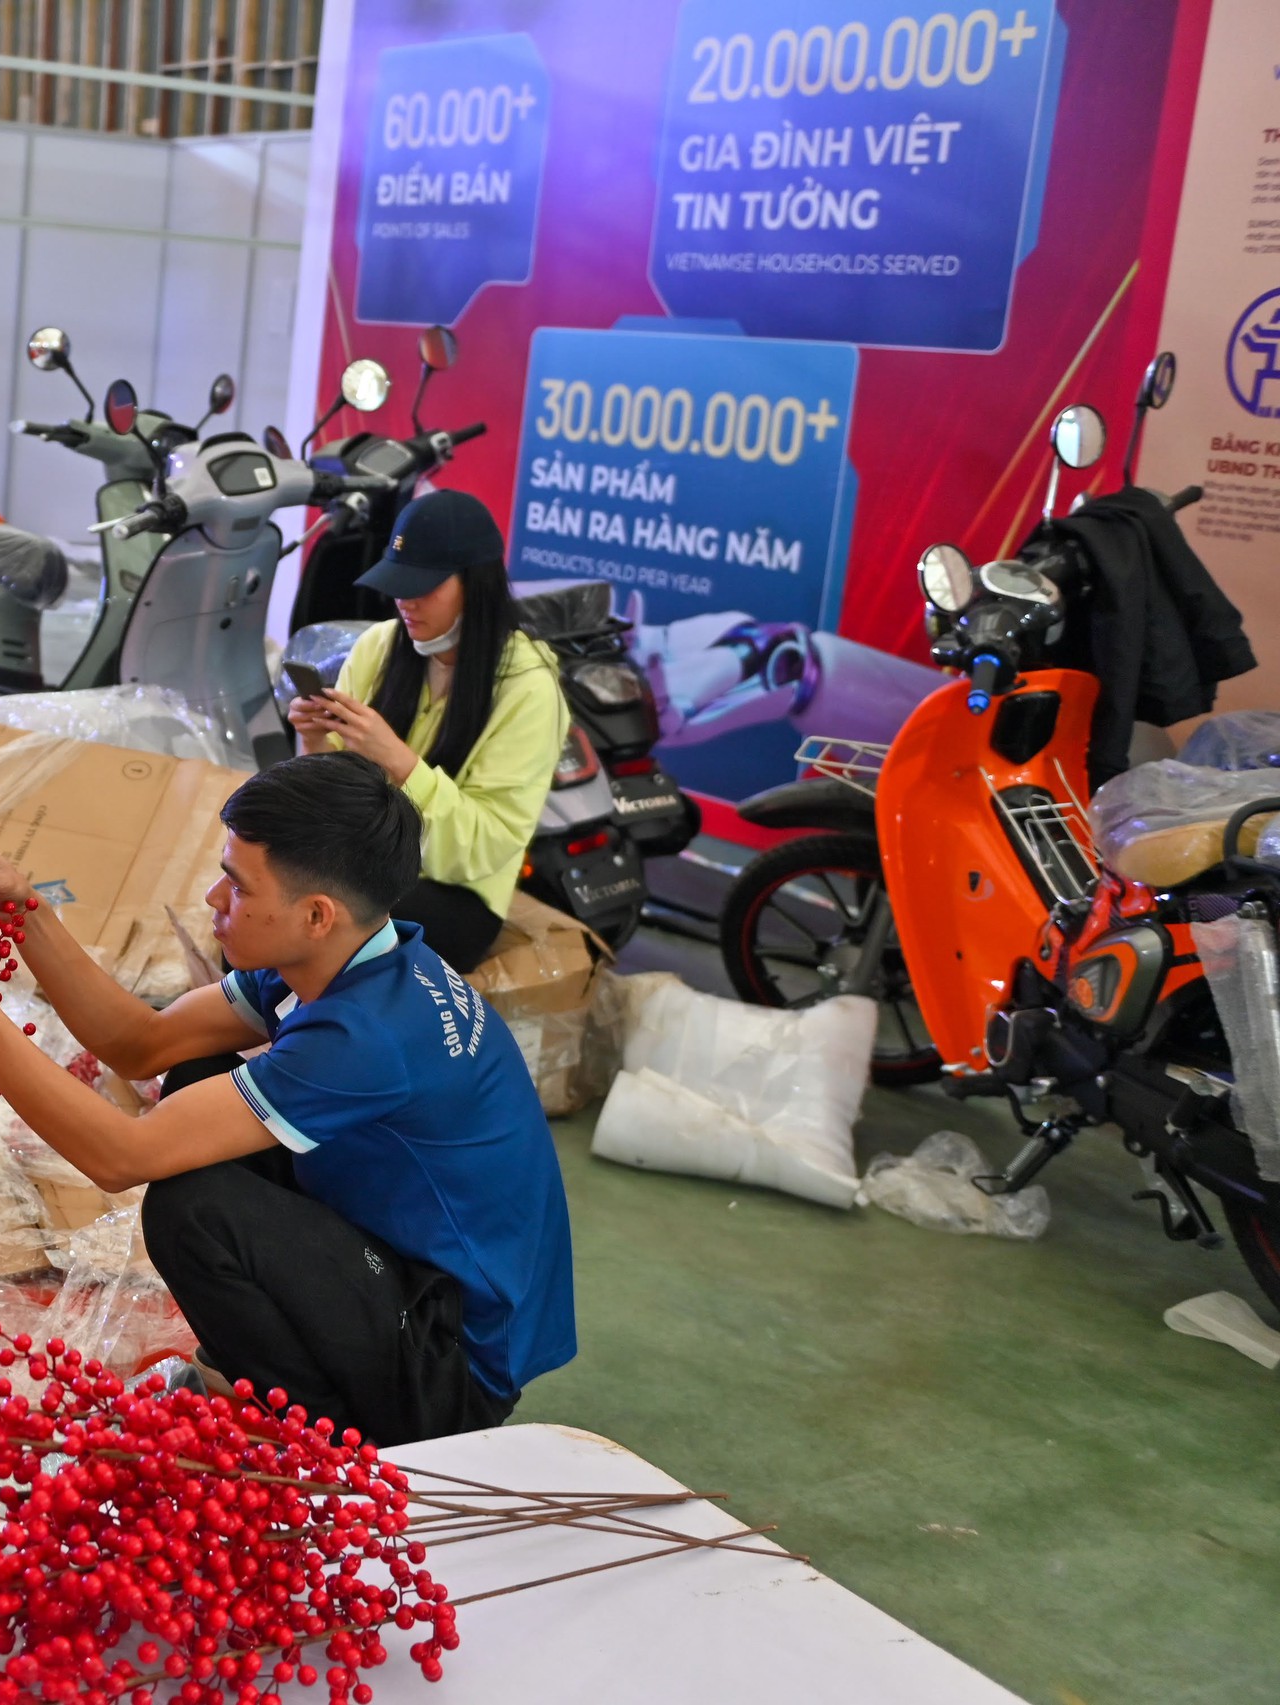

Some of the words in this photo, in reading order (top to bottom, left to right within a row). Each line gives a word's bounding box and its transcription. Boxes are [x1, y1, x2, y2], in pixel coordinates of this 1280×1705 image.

[687, 9, 1038, 104] 20.000.000+
[384, 82, 537, 150] 60.000+
[678, 133, 741, 173] GIA
[749, 120, 853, 171] ĐÌNH
[864, 112, 962, 175] VIỆT
[449, 161, 512, 205] BÁN
[672, 191, 731, 231] TIN
[740, 176, 881, 231] TƯỞNG
[415, 221, 431, 239] OF
[433, 221, 470, 240] SALES
[756, 252, 880, 275] HOUSEHOLDS
[883, 254, 961, 276] SERVED
[536, 378, 838, 466] 30.000.000+
[529, 449, 585, 493] SẢN
[589, 459, 677, 505] PHẨM
[1207, 459, 1257, 476] UBND
[525, 498, 584, 538] BÁN
[587, 510, 627, 546] RA
[631, 513, 720, 560] HÀNG
[724, 527, 803, 574] NĂM
[520, 546, 595, 575] PRODUCTS
[595, 559, 636, 583] SOLD
[637, 566, 668, 587] PER
[669, 571, 714, 596] YEAR
[428, 989, 448, 1006] TY
[439, 1010, 464, 1058] CÔNG
